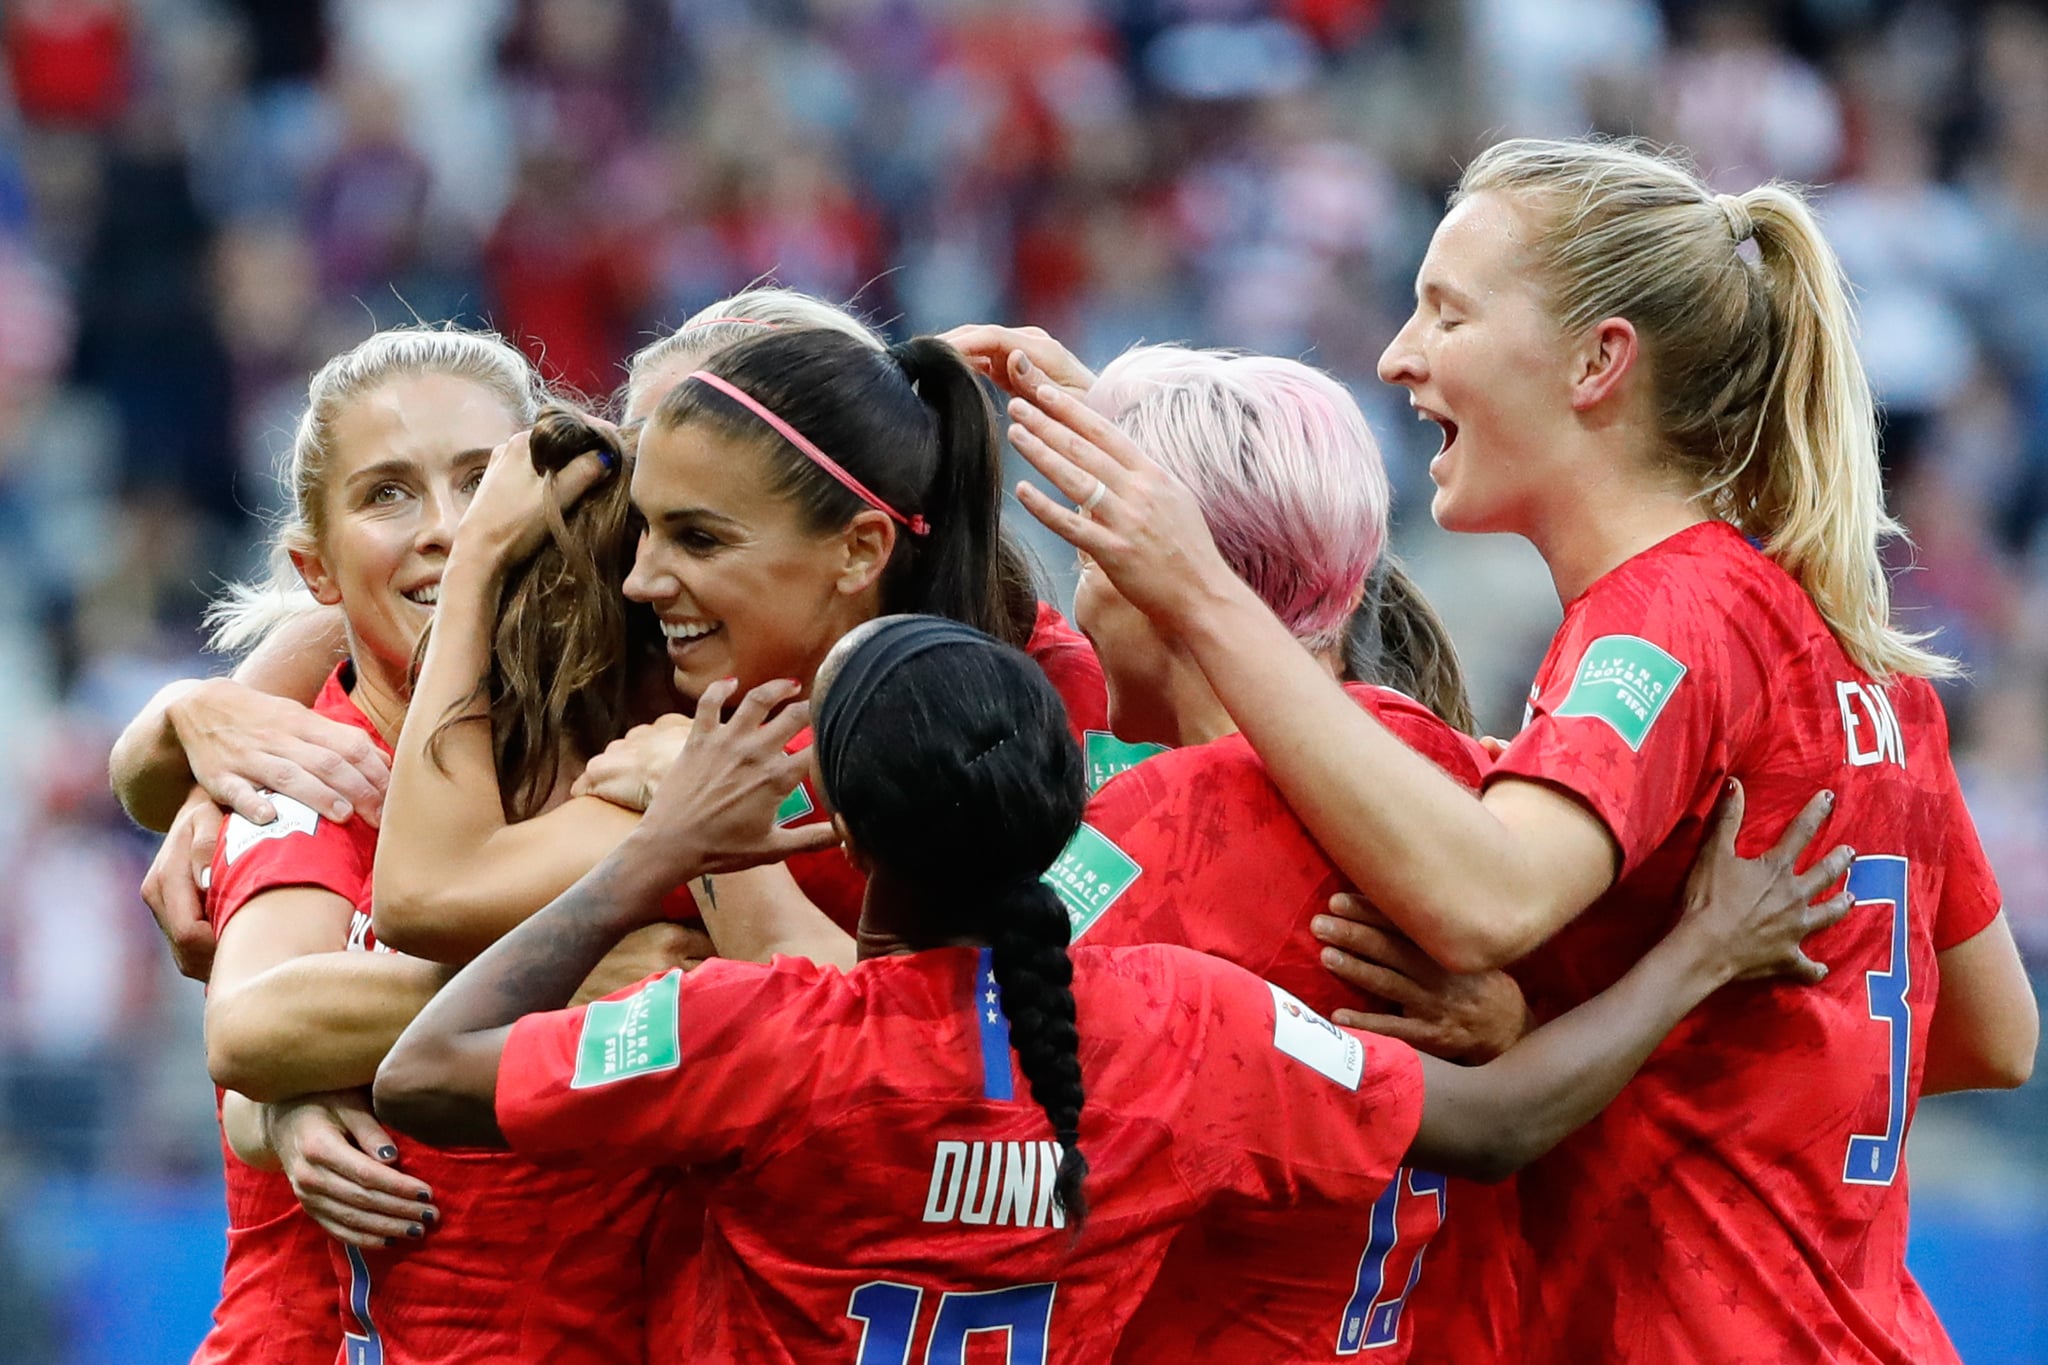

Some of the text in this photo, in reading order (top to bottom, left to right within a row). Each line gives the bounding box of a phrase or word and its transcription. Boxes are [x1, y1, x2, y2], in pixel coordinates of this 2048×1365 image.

[1584, 667, 1656, 703] FOOTBALL
[1587, 658, 1663, 694] LIVING
[1615, 688, 1648, 722] FIFA
[637, 987, 655, 1065] LIVING
[1842, 853, 1912, 1185] 3
[603, 1037, 617, 1075] FIFA
